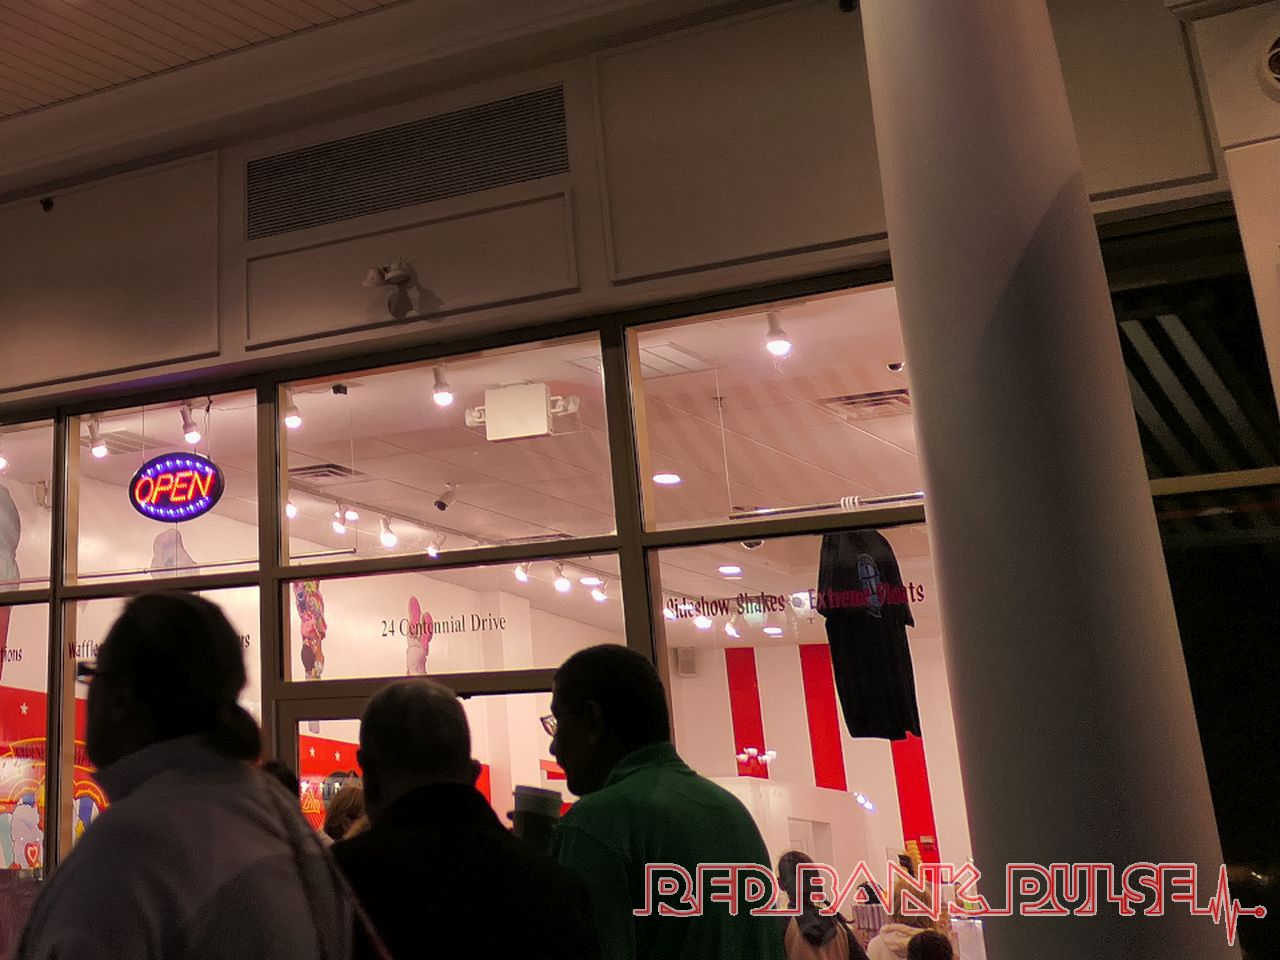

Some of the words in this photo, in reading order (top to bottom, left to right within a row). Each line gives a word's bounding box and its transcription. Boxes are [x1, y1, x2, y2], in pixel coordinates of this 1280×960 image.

[134, 470, 215, 504] OPEN
[666, 596, 729, 619] Sideshow
[736, 592, 786, 615] Shakes
[381, 620, 396, 637] 24
[399, 614, 466, 637] Centennial
[470, 612, 507, 632] Drive
